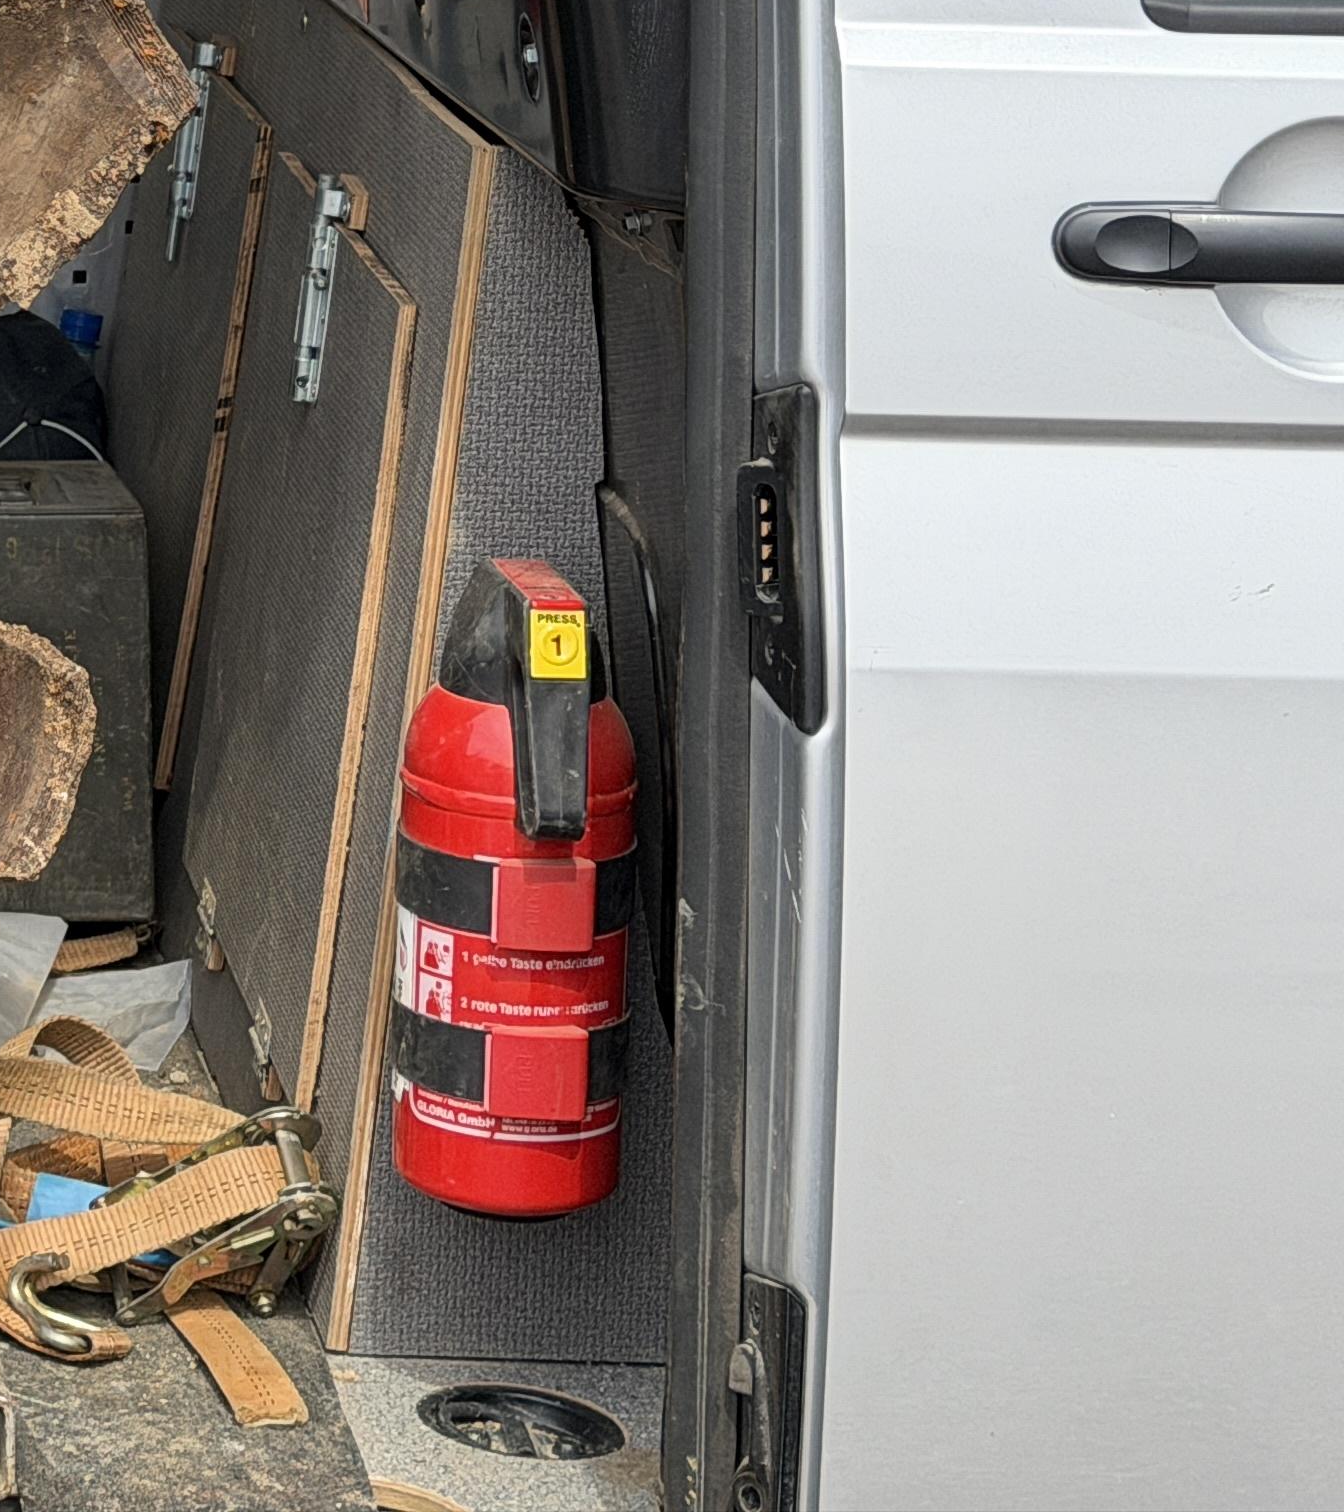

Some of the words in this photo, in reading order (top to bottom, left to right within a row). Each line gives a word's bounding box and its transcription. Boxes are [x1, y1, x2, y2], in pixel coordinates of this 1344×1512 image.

[537, 613, 578, 625] PRESS
[550, 634, 562, 657] 1
[461, 950, 469, 963] 1
[510, 956, 543, 970] Taste
[460, 995, 468, 1009] 2
[470, 999, 498, 1014] rote
[498, 1002, 532, 1017] Taste
[416, 1098, 456, 1123] GLORIA
[457, 1111, 496, 1129] GmbH
